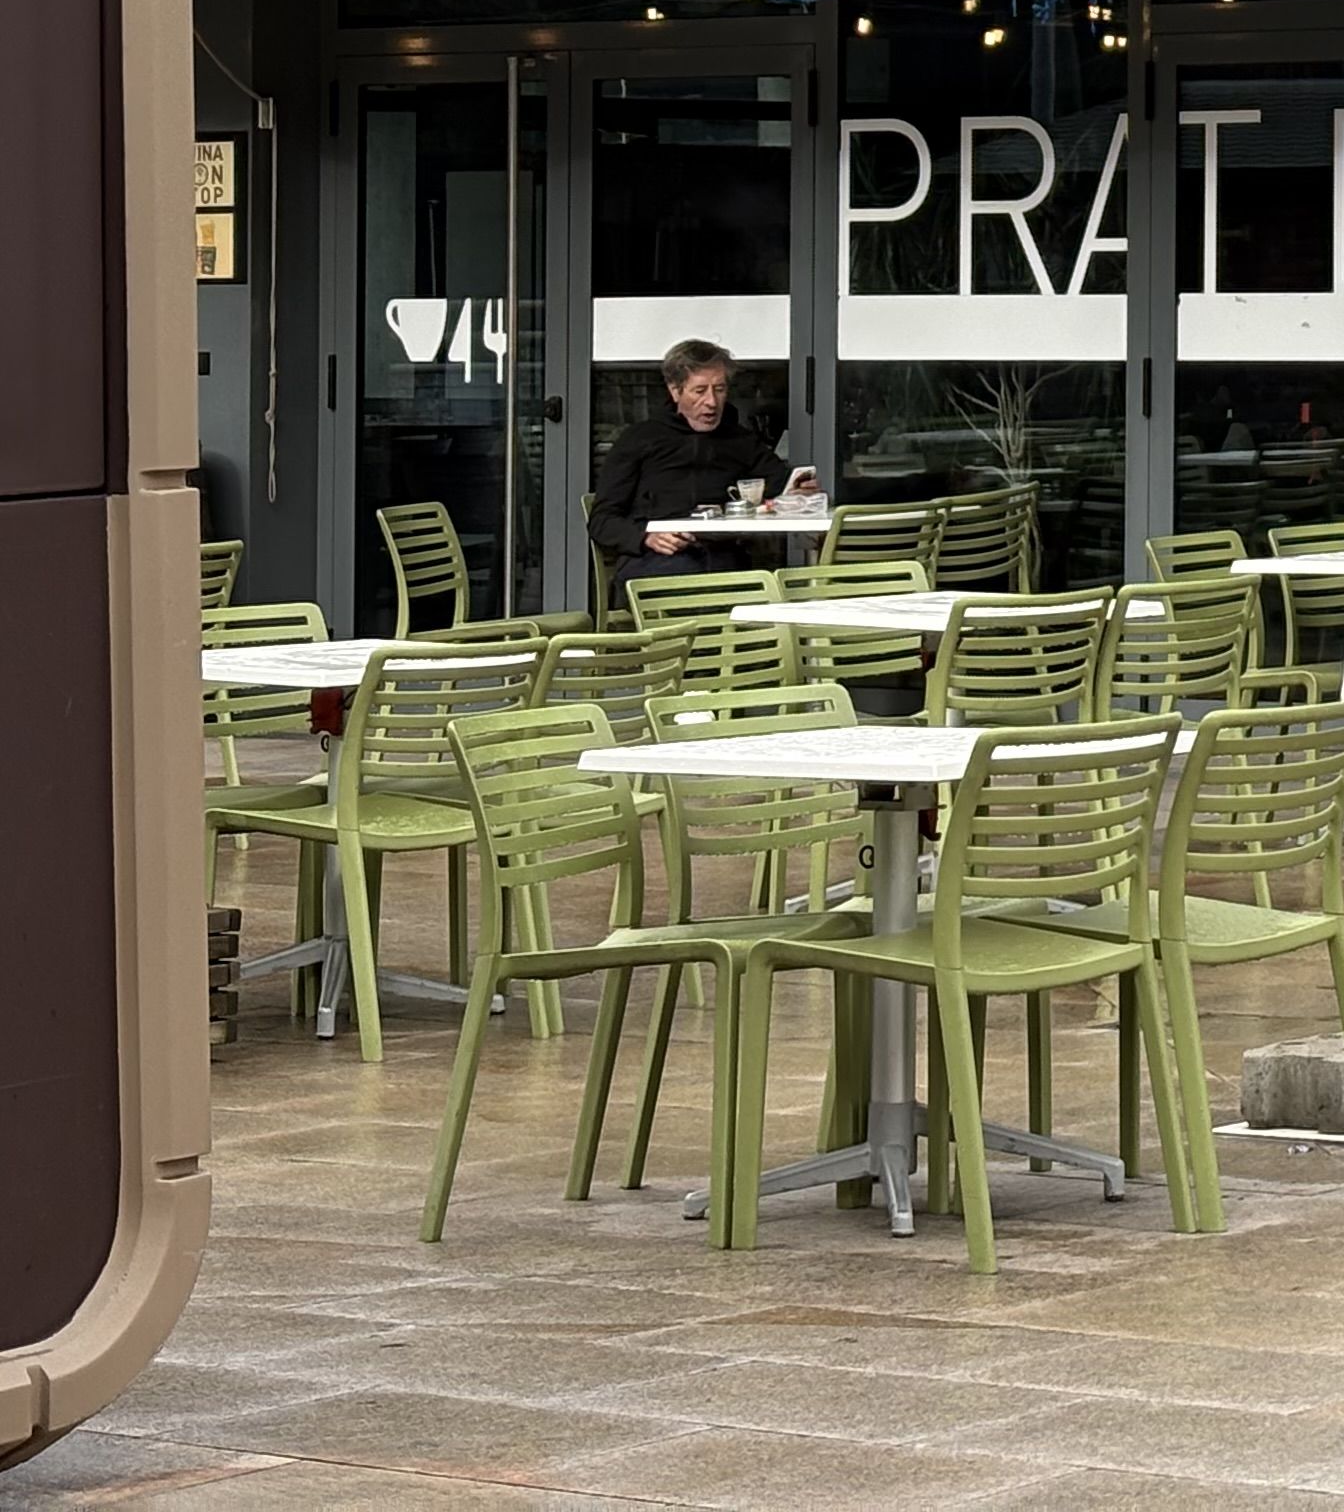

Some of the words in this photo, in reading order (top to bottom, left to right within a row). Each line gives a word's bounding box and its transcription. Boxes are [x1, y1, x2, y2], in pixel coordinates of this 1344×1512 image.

[194, 144, 224, 162] INA
[194, 163, 224, 186] ON
[194, 186, 224, 205] OP
